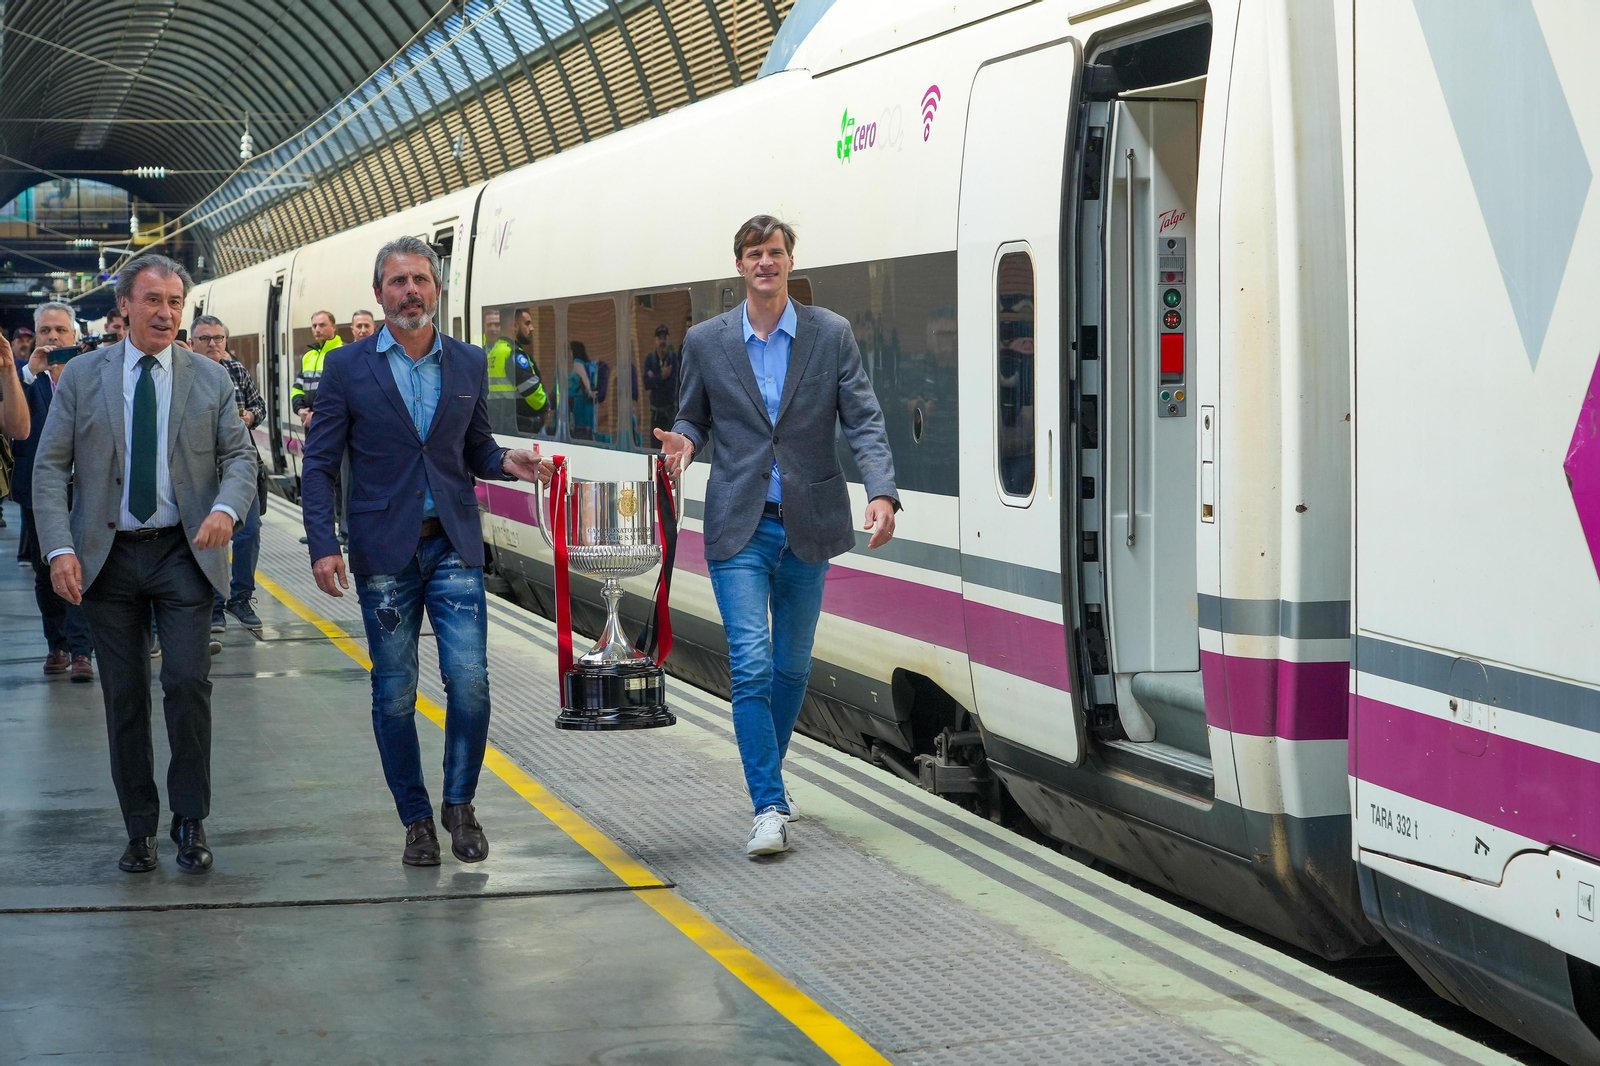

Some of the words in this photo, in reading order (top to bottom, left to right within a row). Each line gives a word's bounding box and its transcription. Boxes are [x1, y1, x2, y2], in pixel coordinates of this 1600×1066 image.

[1159, 209, 1187, 233] Talgo
[1371, 803, 1393, 831] TARA
[1396, 813, 1411, 838] 332
[1414, 820, 1419, 840] t
